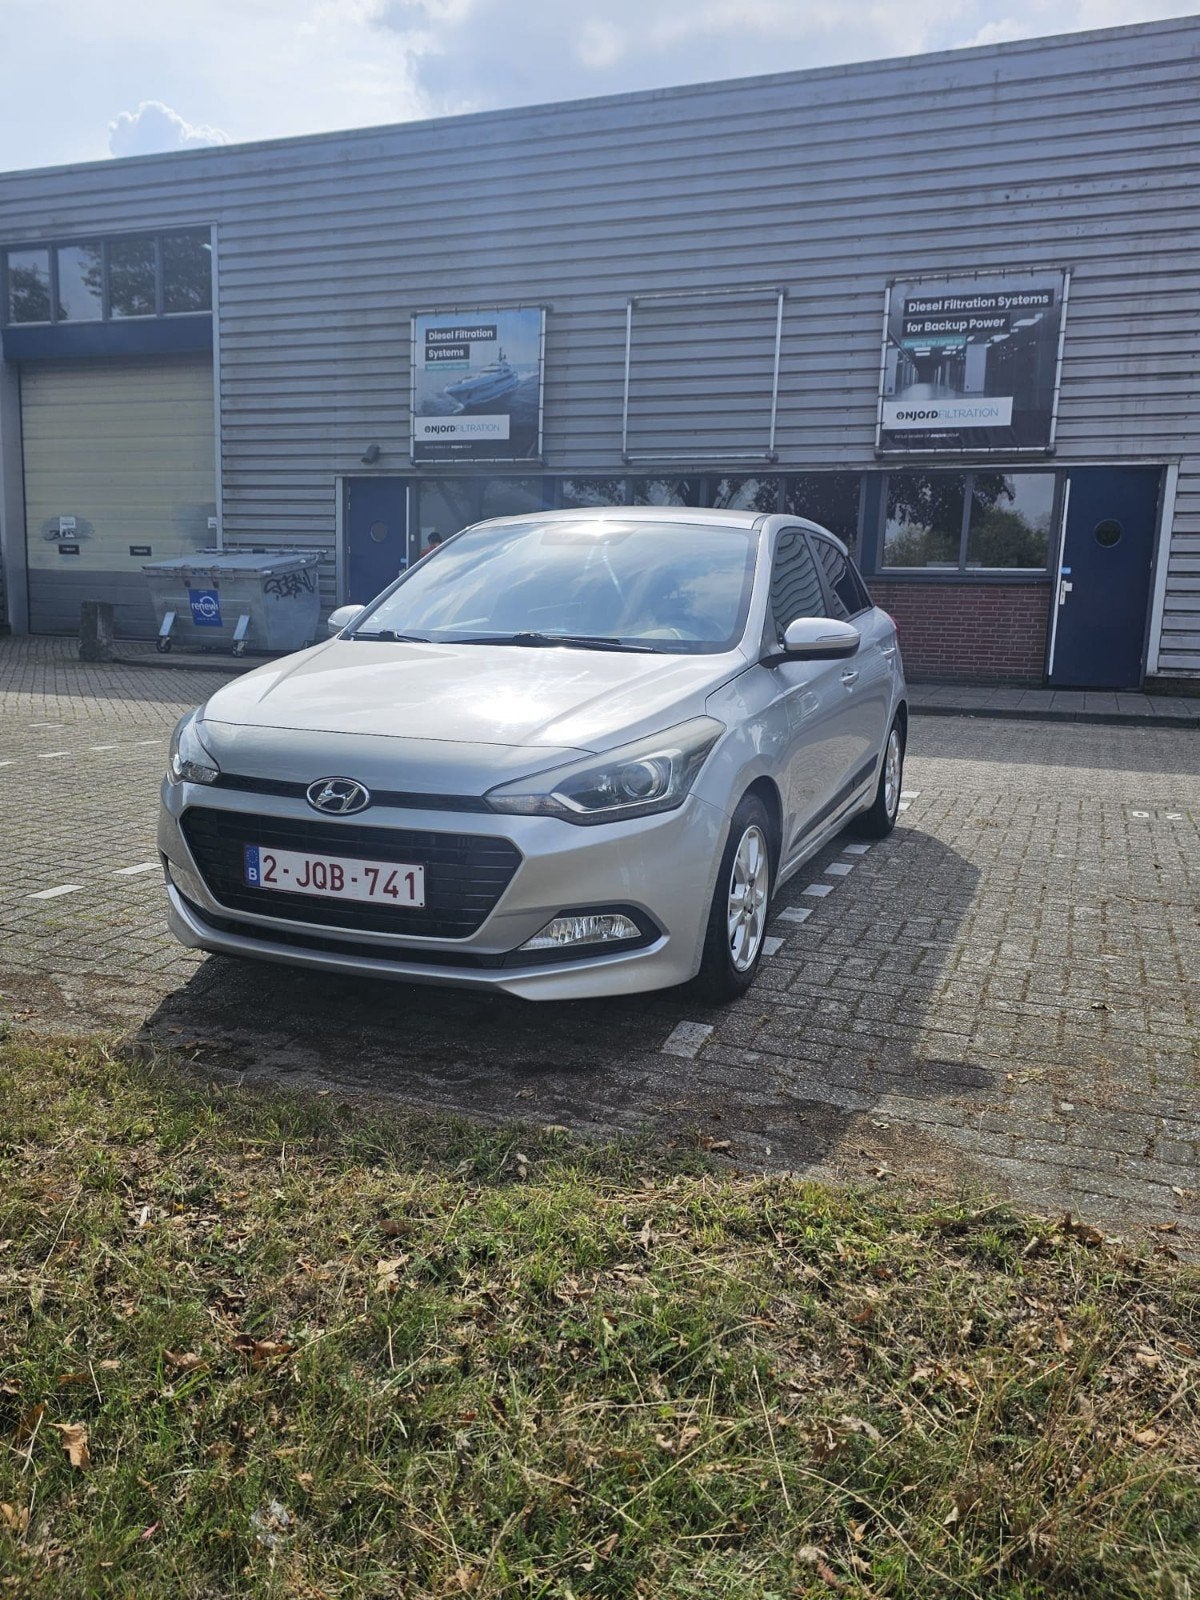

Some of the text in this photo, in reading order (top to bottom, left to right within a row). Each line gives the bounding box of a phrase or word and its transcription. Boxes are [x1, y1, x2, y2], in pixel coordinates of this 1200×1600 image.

[908, 293, 1049, 313] Diesel Filtration Systems
[907, 317, 1006, 333] for Backup Power
[428, 328, 493, 341] Diesel Filtration
[428, 348, 464, 360] Systems
[191, 601, 219, 610] renewi
[248, 854, 416, 900] B 2-JQB-741
